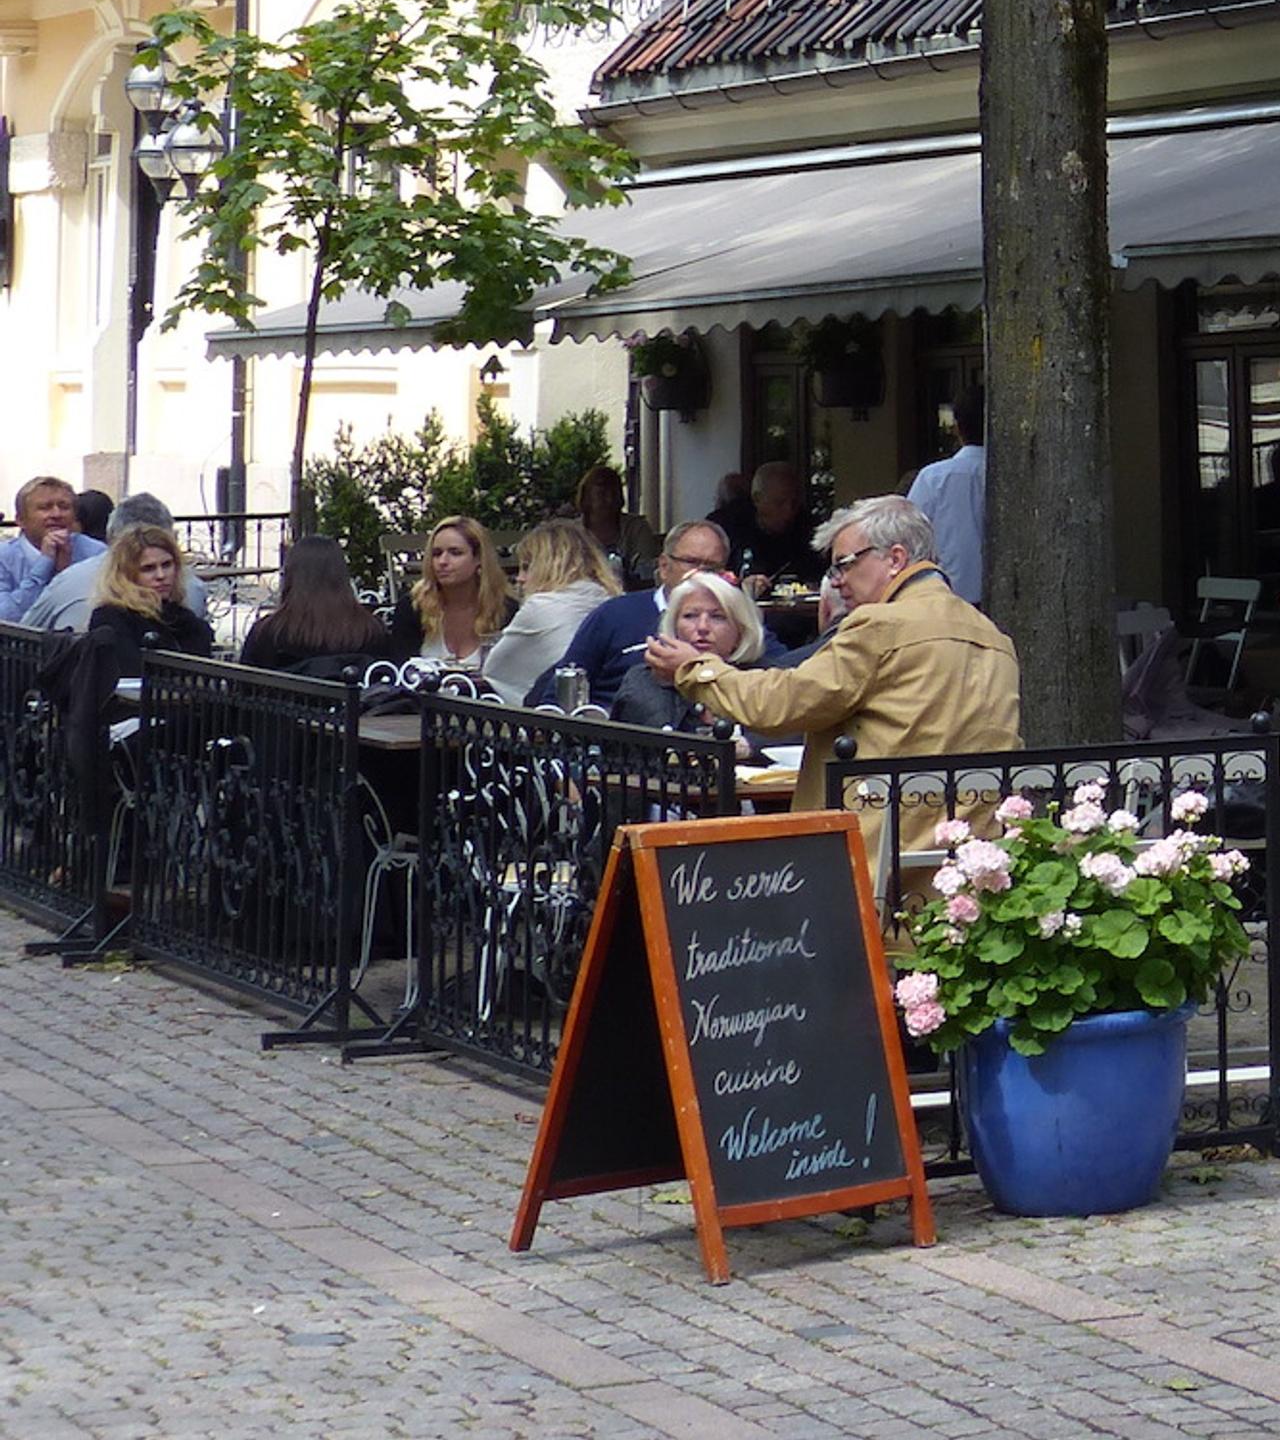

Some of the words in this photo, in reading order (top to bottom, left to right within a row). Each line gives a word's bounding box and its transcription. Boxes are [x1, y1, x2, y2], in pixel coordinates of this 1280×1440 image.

[670, 851, 718, 905] We
[726, 861, 805, 900] serve
[685, 918, 817, 981] traditional
[690, 994, 806, 1047] Norwegian
[714, 1059, 800, 1095] cuisine
[720, 1107, 826, 1161] Welcome
